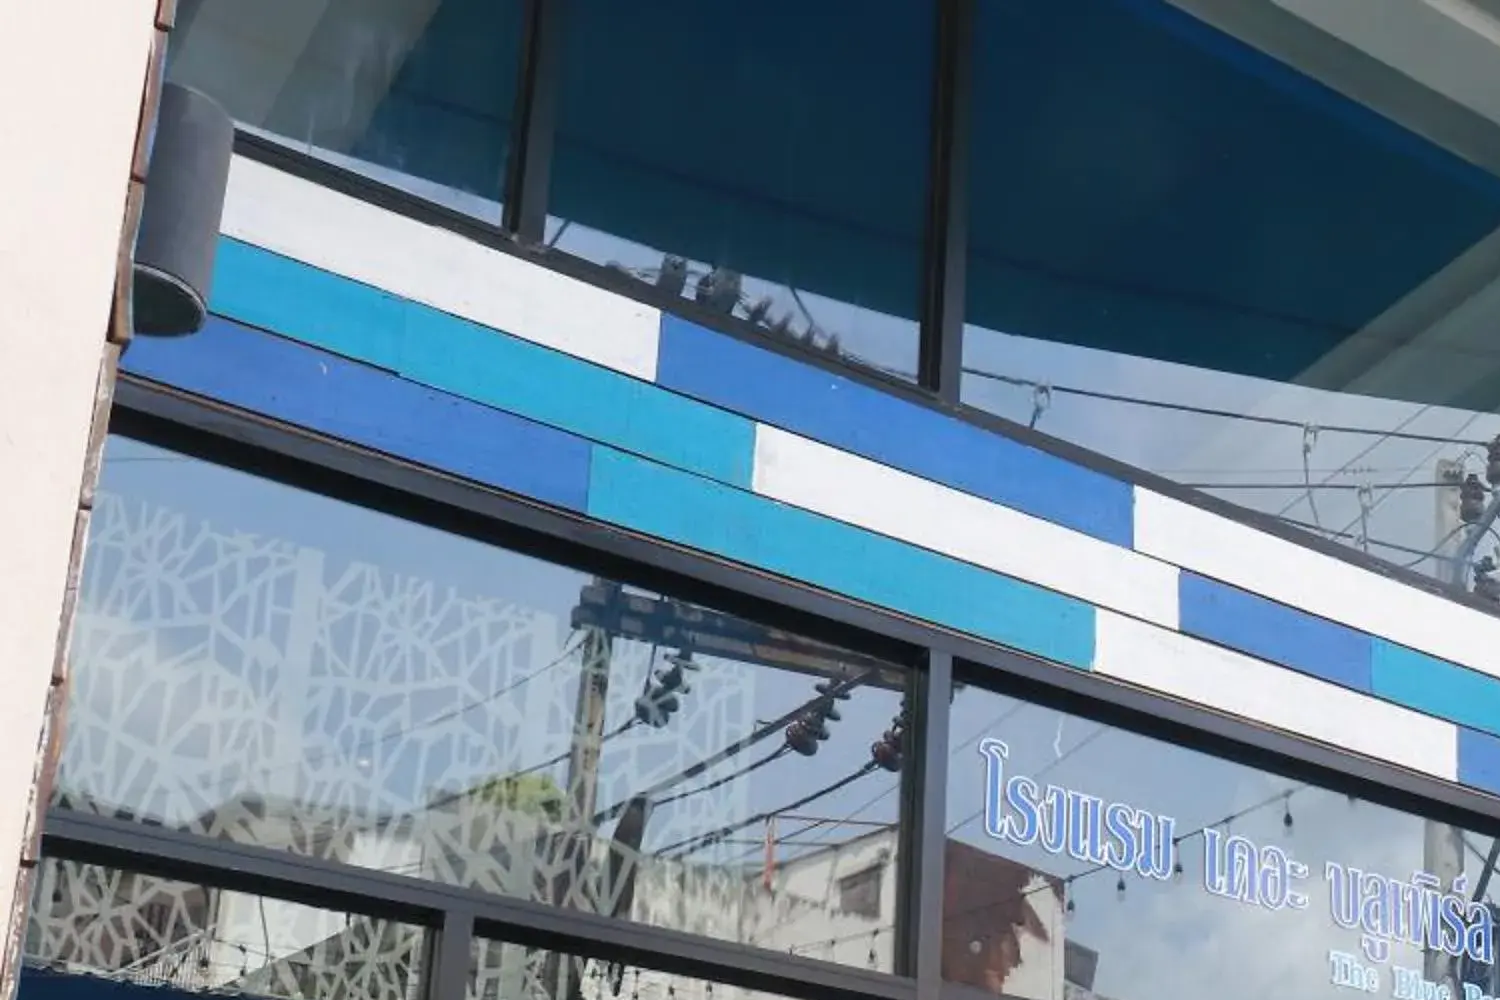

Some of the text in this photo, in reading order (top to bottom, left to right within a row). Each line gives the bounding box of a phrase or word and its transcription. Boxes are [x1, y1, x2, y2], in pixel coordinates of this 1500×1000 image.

[979, 737, 1175, 881] โรงแรม
[1329, 949, 1380, 994] The
